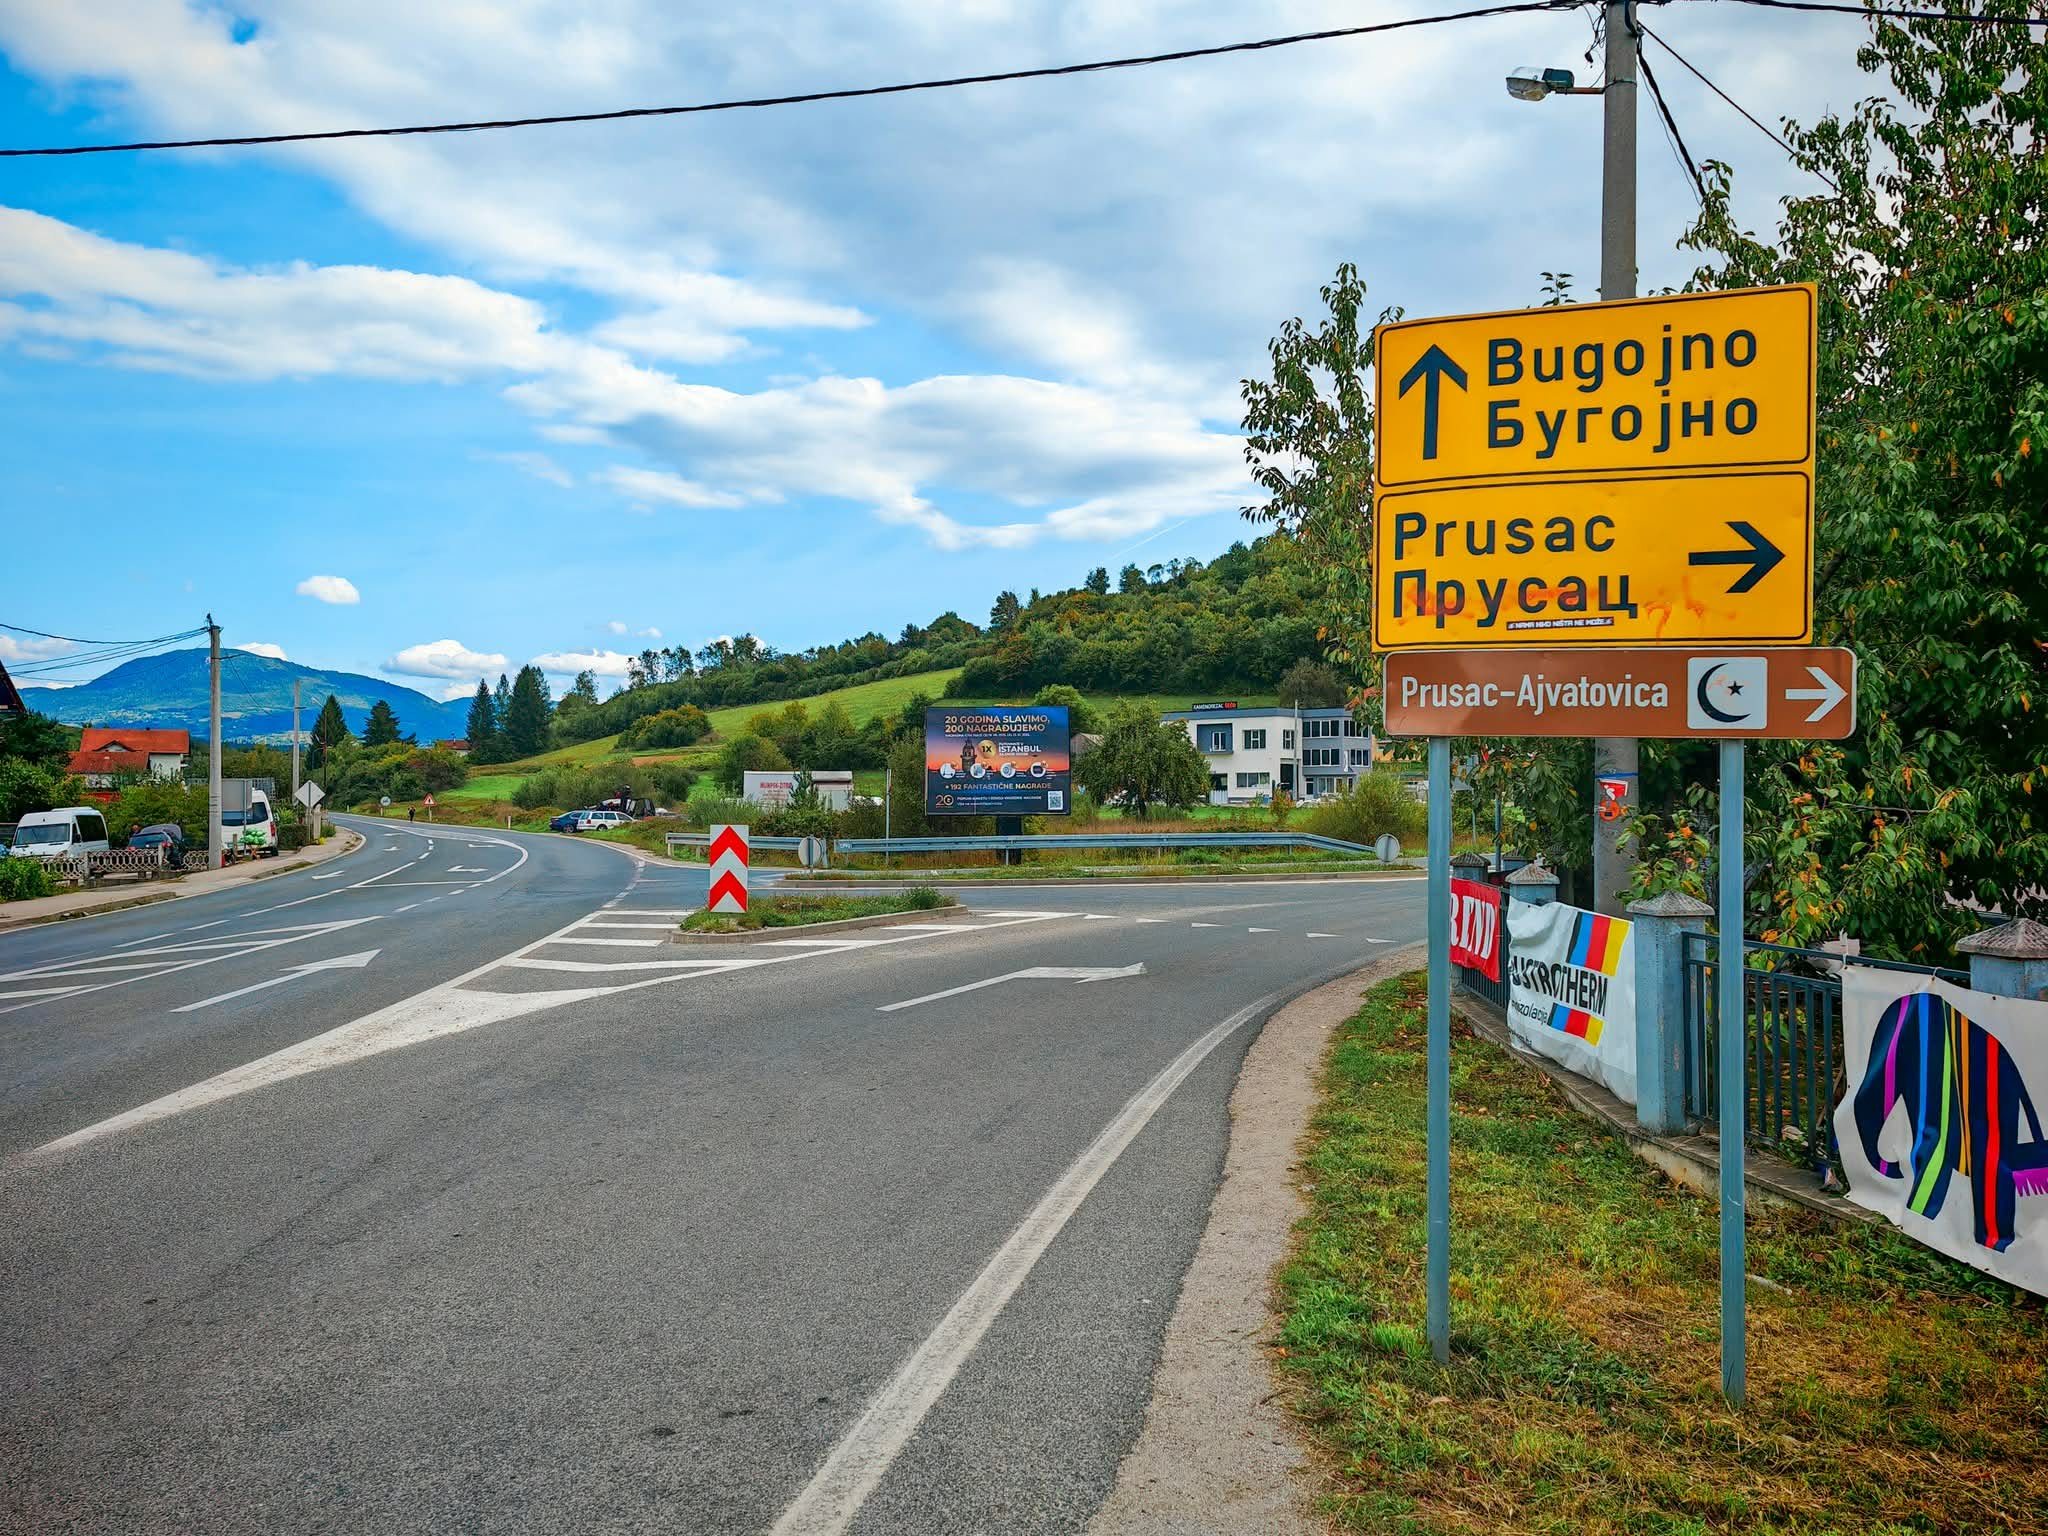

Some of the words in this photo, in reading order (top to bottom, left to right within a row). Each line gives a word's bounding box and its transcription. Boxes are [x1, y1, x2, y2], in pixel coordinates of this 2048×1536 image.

[1488, 325, 1757, 393] Bugojno
[1488, 389, 1758, 460] Бугојно
[1394, 511, 1616, 561] Prusac
[1393, 568, 1638, 629] Прусац
[1401, 674, 1669, 716] Prusac-Ajvatovica
[945, 716, 958, 724] 20
[960, 716, 1001, 724] GODINA
[945, 724, 964, 733] 200
[1015, 782, 1052, 790] NAGRADE
